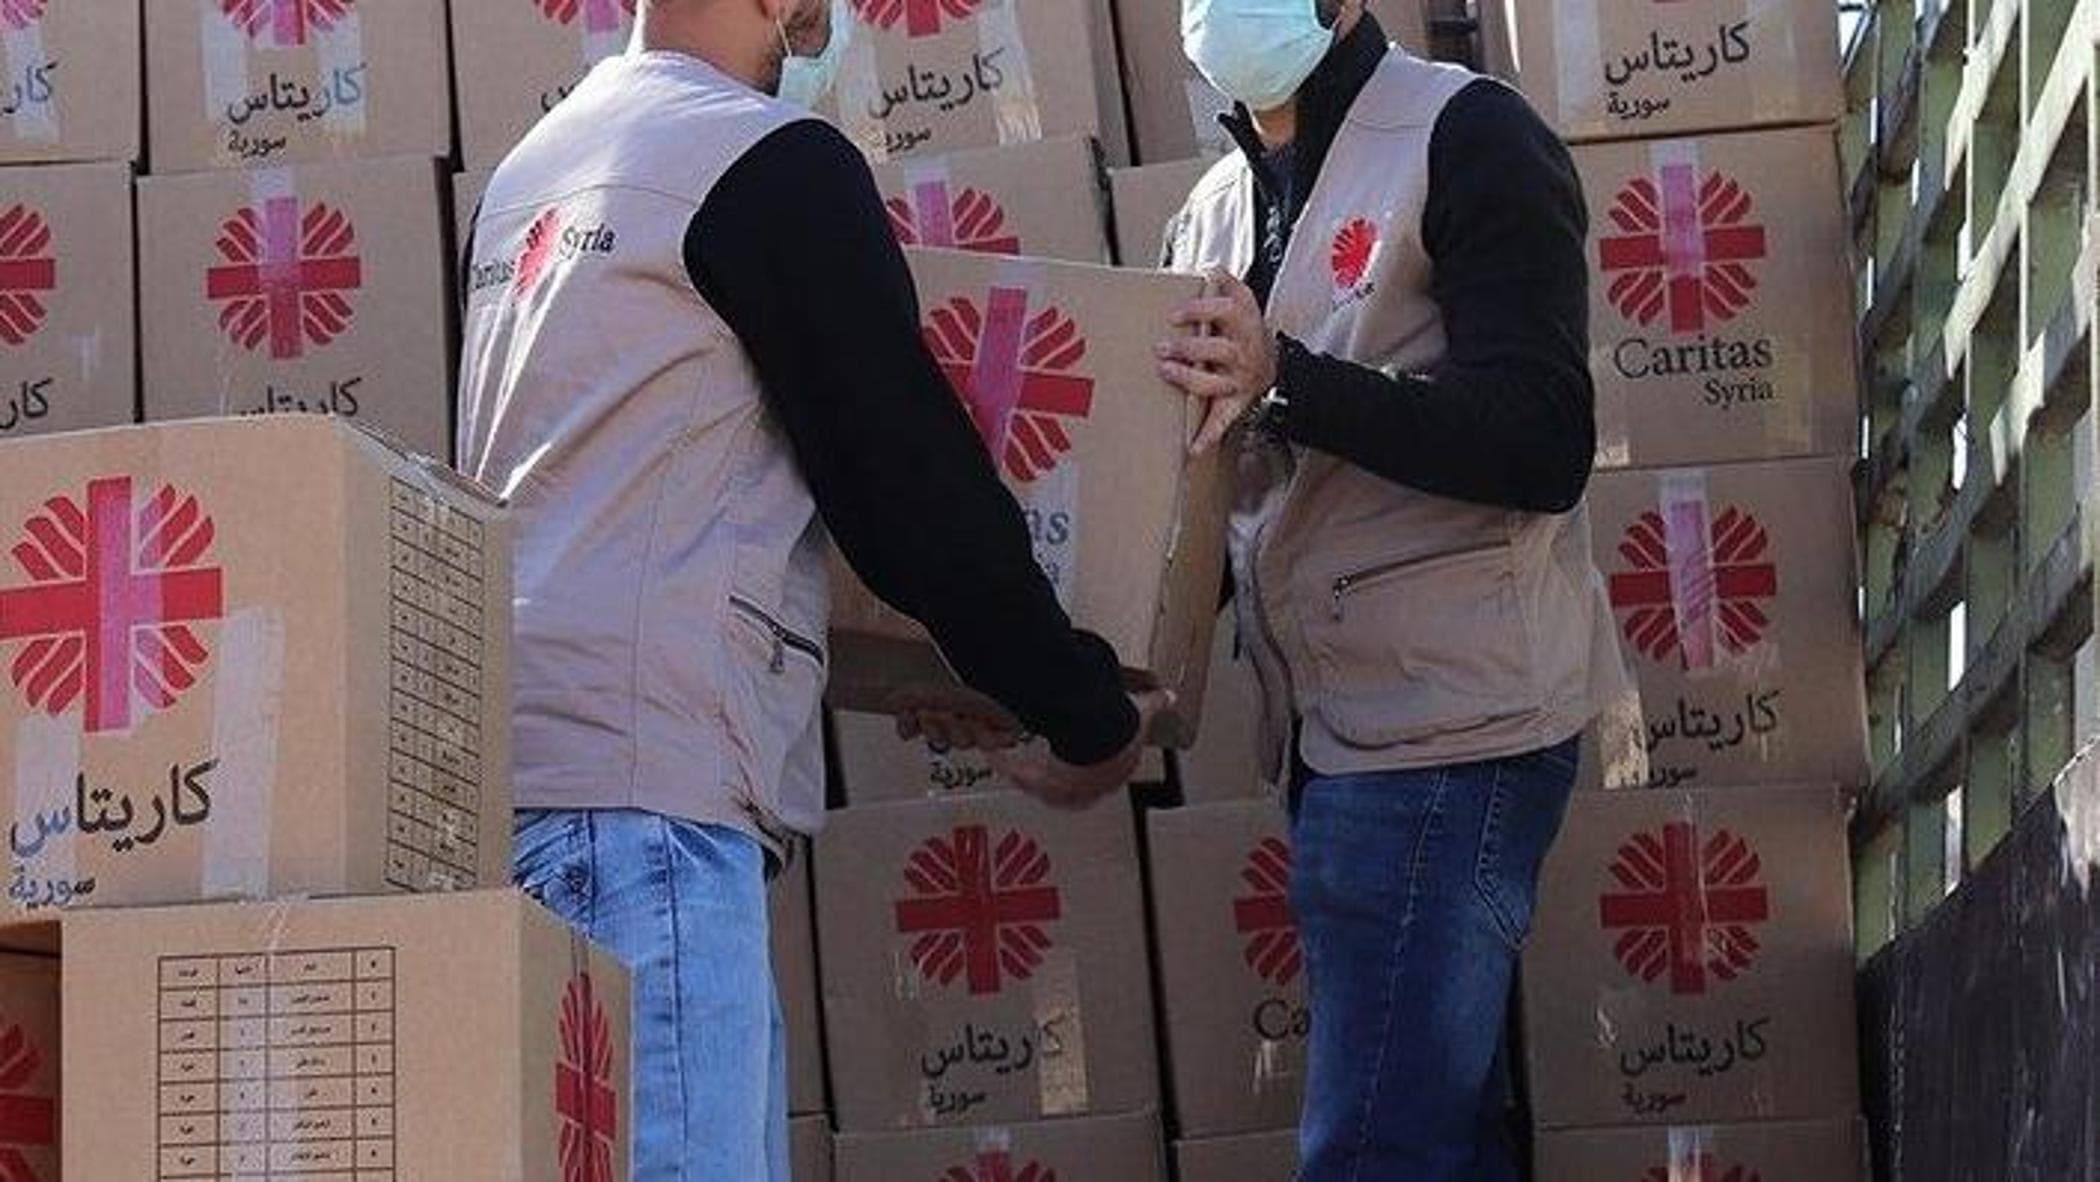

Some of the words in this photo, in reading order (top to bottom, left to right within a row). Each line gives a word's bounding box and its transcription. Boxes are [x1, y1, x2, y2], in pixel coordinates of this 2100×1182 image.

[1604, 21, 1750, 86] كاريتاس
[228, 62, 367, 125] كاريتاس
[869, 47, 1005, 119] كاريتاس
[1608, 91, 1670, 120] سورية
[885, 128, 932, 153] سوري
[1614, 334, 1774, 379] Caritas
[1704, 378, 1774, 411] Syria
[10, 758, 220, 857] كاريتاس
[8, 864, 96, 909] سورية
[1620, 1017, 1771, 1077] كاريتاس
